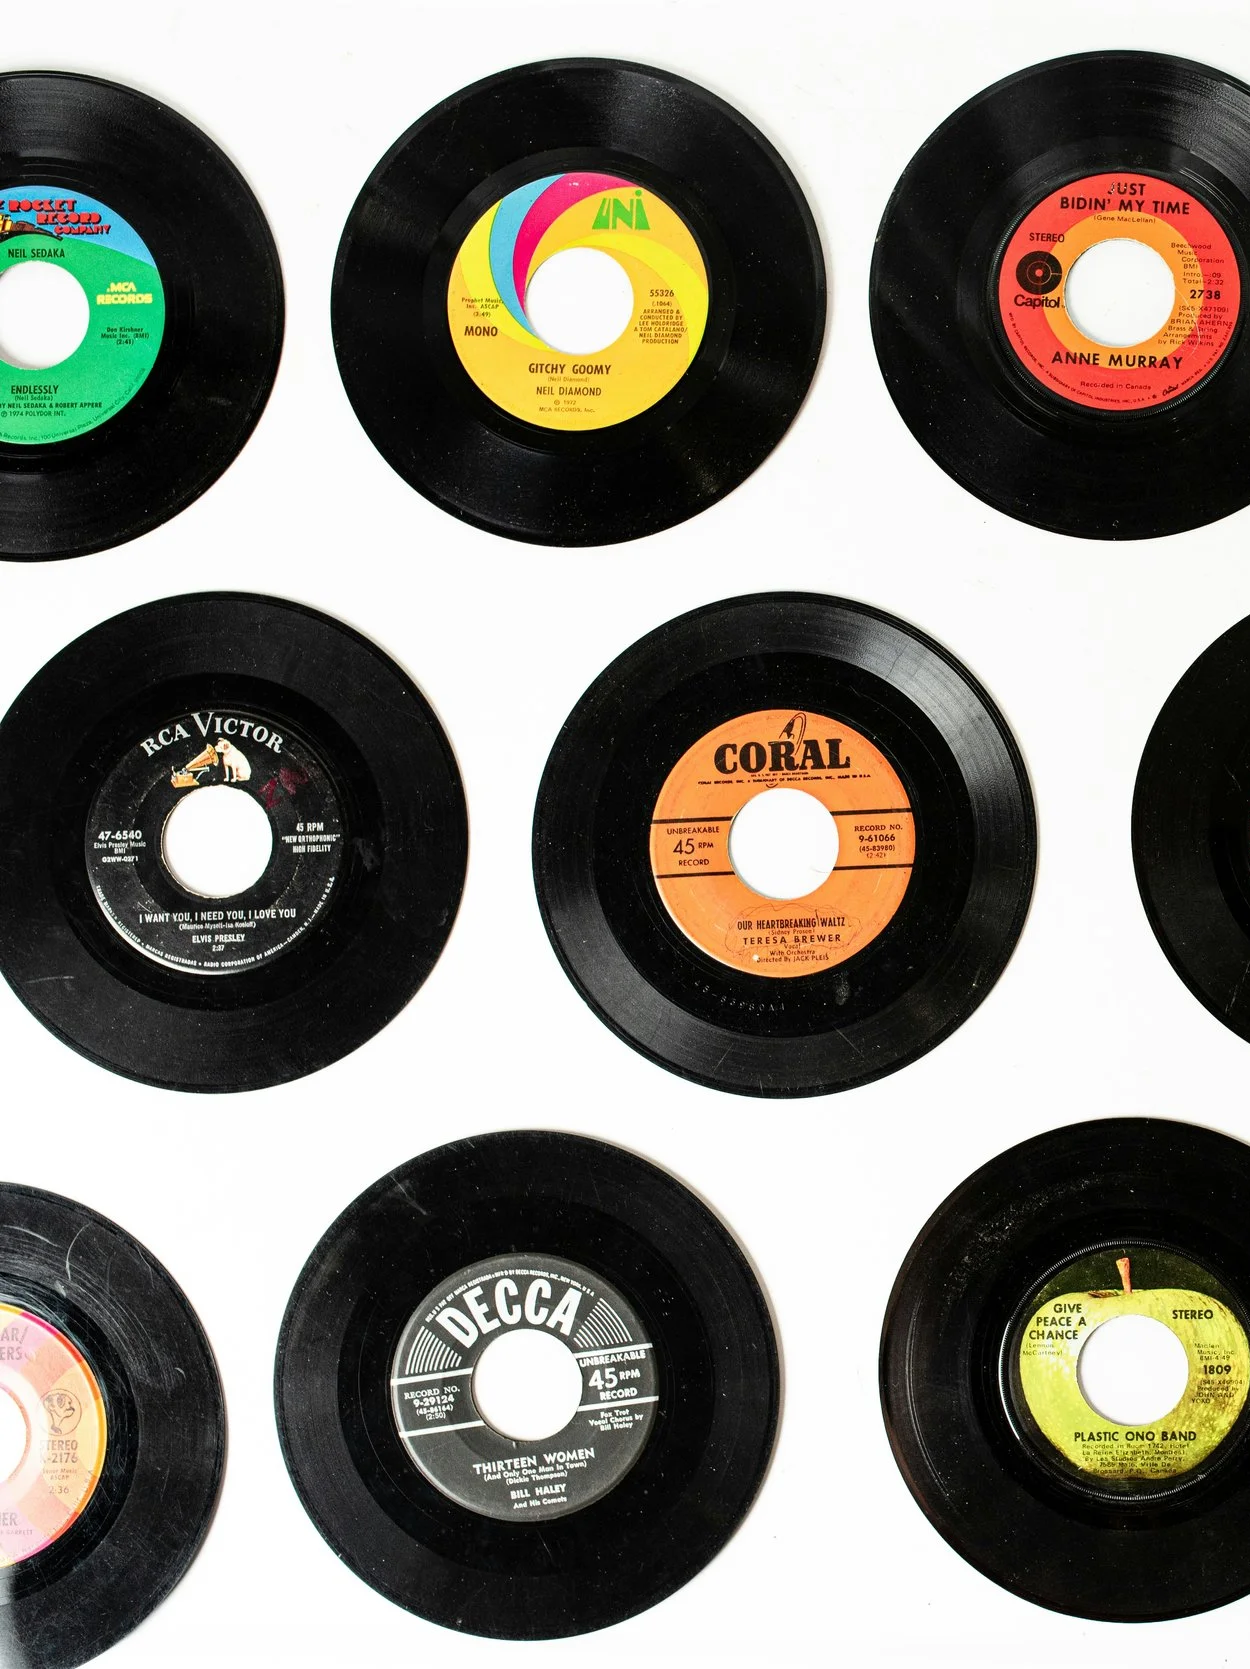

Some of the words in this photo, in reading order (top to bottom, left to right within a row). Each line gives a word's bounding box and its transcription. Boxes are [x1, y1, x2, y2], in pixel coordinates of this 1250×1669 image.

[1108, 183, 1146, 195] JUST
[8, 199, 76, 212] ROCKET
[1060, 197, 1111, 211] BIDIN'
[1119, 201, 1144, 212] MY
[1153, 201, 1190, 214] TIME
[36, 212, 101, 224] RECORD
[54, 225, 110, 235] COMPANY
[1029, 233, 1064, 242] STEREO
[8, 249, 27, 258] NEIL
[31, 249, 65, 258] SEDAKA
[97, 294, 152, 304] RECORDS
[1190, 290, 1221, 300] 2738
[1014, 295, 1060, 309] Capitol
[464, 326, 498, 336] MONO
[1052, 352, 1100, 365] ANNE
[1109, 354, 1183, 369] MURRAY
[529, 363, 565, 374] GITCHY
[572, 364, 611, 375] GOOMY
[11, 385, 59, 394] ENDLESSLY
[536, 386, 554, 396] NEIL
[559, 387, 601, 396] DIAMOND
[140, 724, 190, 757] RCA
[192, 711, 284, 753] VICTOR
[714, 739, 851, 774] CORAL
[98, 830, 142, 840] 47-6540
[667, 826, 720, 835] UNBREAKABLE
[859, 834, 896, 843] 9-61066
[673, 839, 695, 855] 45
[678, 859, 710, 867] RECORD
[140, 914, 142, 923] I
[145, 914, 170, 923] WANT
[173, 913, 192, 923] YOU,
[195, 912, 198, 921] I
[201, 911, 223, 921] NEED
[226, 911, 246, 921] YOU,
[249, 910, 252, 919] I
[255, 909, 276, 919] LOVE
[279, 908, 296, 918] YOU
[737, 921, 753, 930] OUR
[756, 918, 817, 930] HEARTBREAKING
[820, 917, 845, 928] WALTZ
[192, 935, 211, 943] ELVIS
[215, 934, 245, 943] PRESLEY
[743, 936, 787, 945] TERESA
[794, 934, 841, 943] BREWER
[435, 1279, 582, 1348] DECCA
[1054, 1304, 1082, 1314] GIVE
[1173, 1310, 1213, 1319] STEREO
[1036, 1317, 1072, 1327] PEACE
[1078, 1317, 1086, 1326] A
[1029, 1330, 1078, 1340] CHANCE
[579, 1350, 646, 1367] UNBREAKABLE
[1203, 1365, 1231, 1375] 1809
[589, 1368, 618, 1390] 45
[619, 1369, 640, 1380] RPM
[404, 1387, 439, 1400] RECORD
[600, 1388, 638, 1401] RECORD
[413, 1395, 455, 1407] 9-29124
[1074, 1432, 1119, 1442] PLASTIC
[1125, 1432, 1155, 1441] ONO
[1161, 1431, 1197, 1441] BAND
[473, 1456, 537, 1475] THIRTEEN
[544, 1448, 595, 1464] WOMEN
[511, 1489, 530, 1499] BILL
[535, 1484, 566, 1496] HALEY
